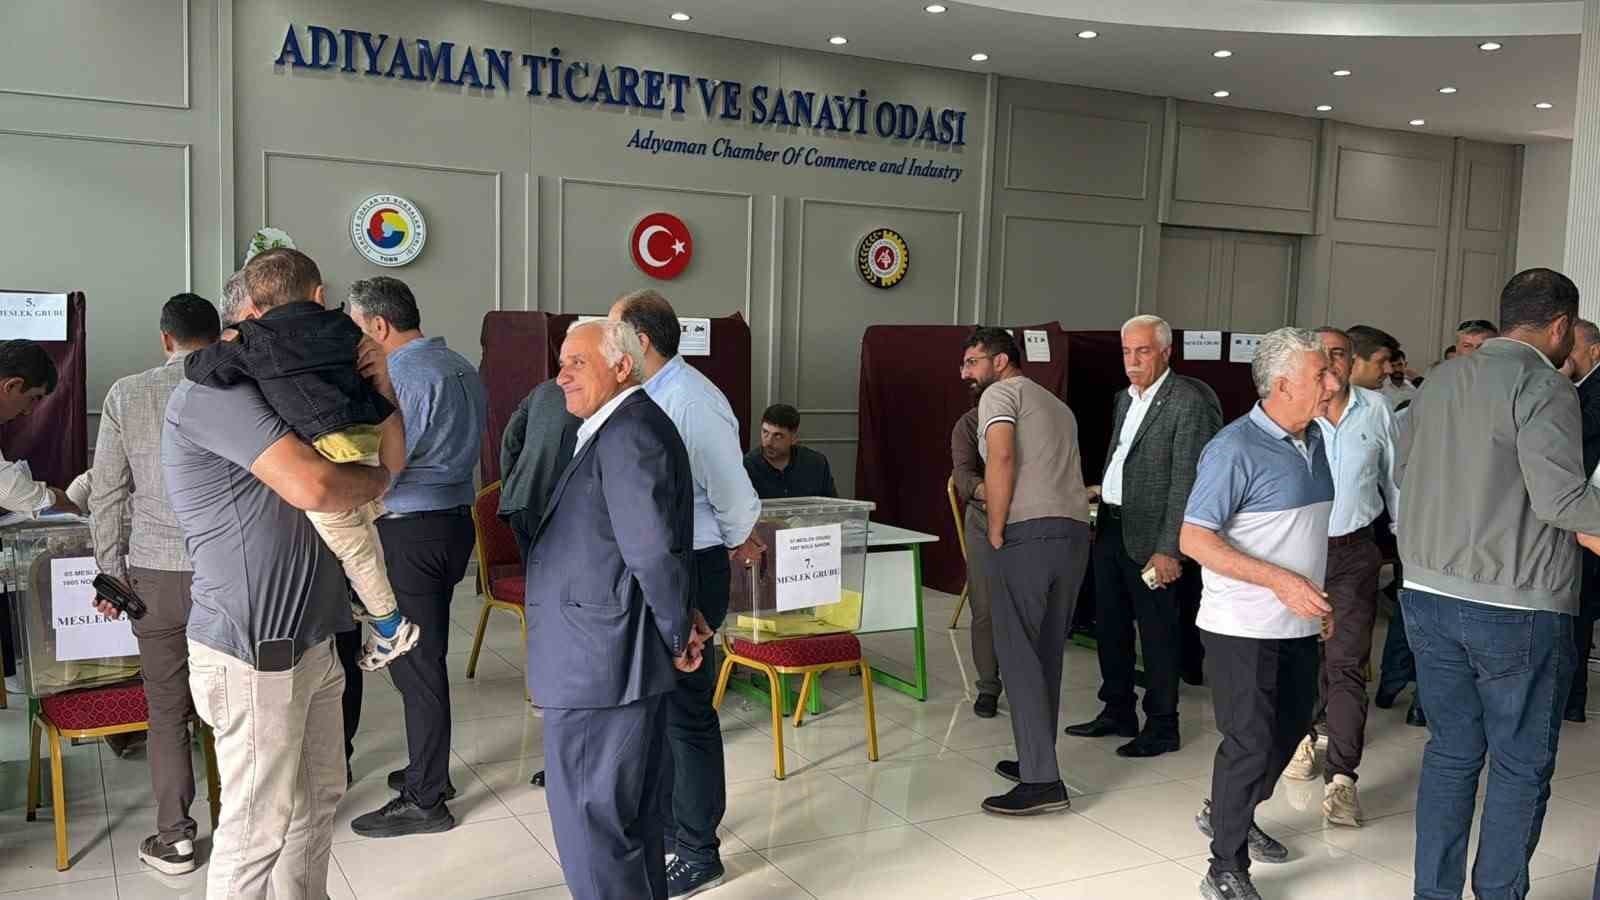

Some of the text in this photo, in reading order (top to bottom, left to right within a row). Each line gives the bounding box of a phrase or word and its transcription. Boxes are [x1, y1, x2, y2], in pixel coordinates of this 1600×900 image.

[274, 23, 967, 146] ADIYAMAN TİCARET VE SANAYİ ODASI
[627, 128, 963, 183] Adıyaman Chamber Of Commerce and Industry
[25, 297, 36, 307] 5.
[804, 557, 814, 568] 7.
[777, 568, 840, 584] MESLEK GRUBU
